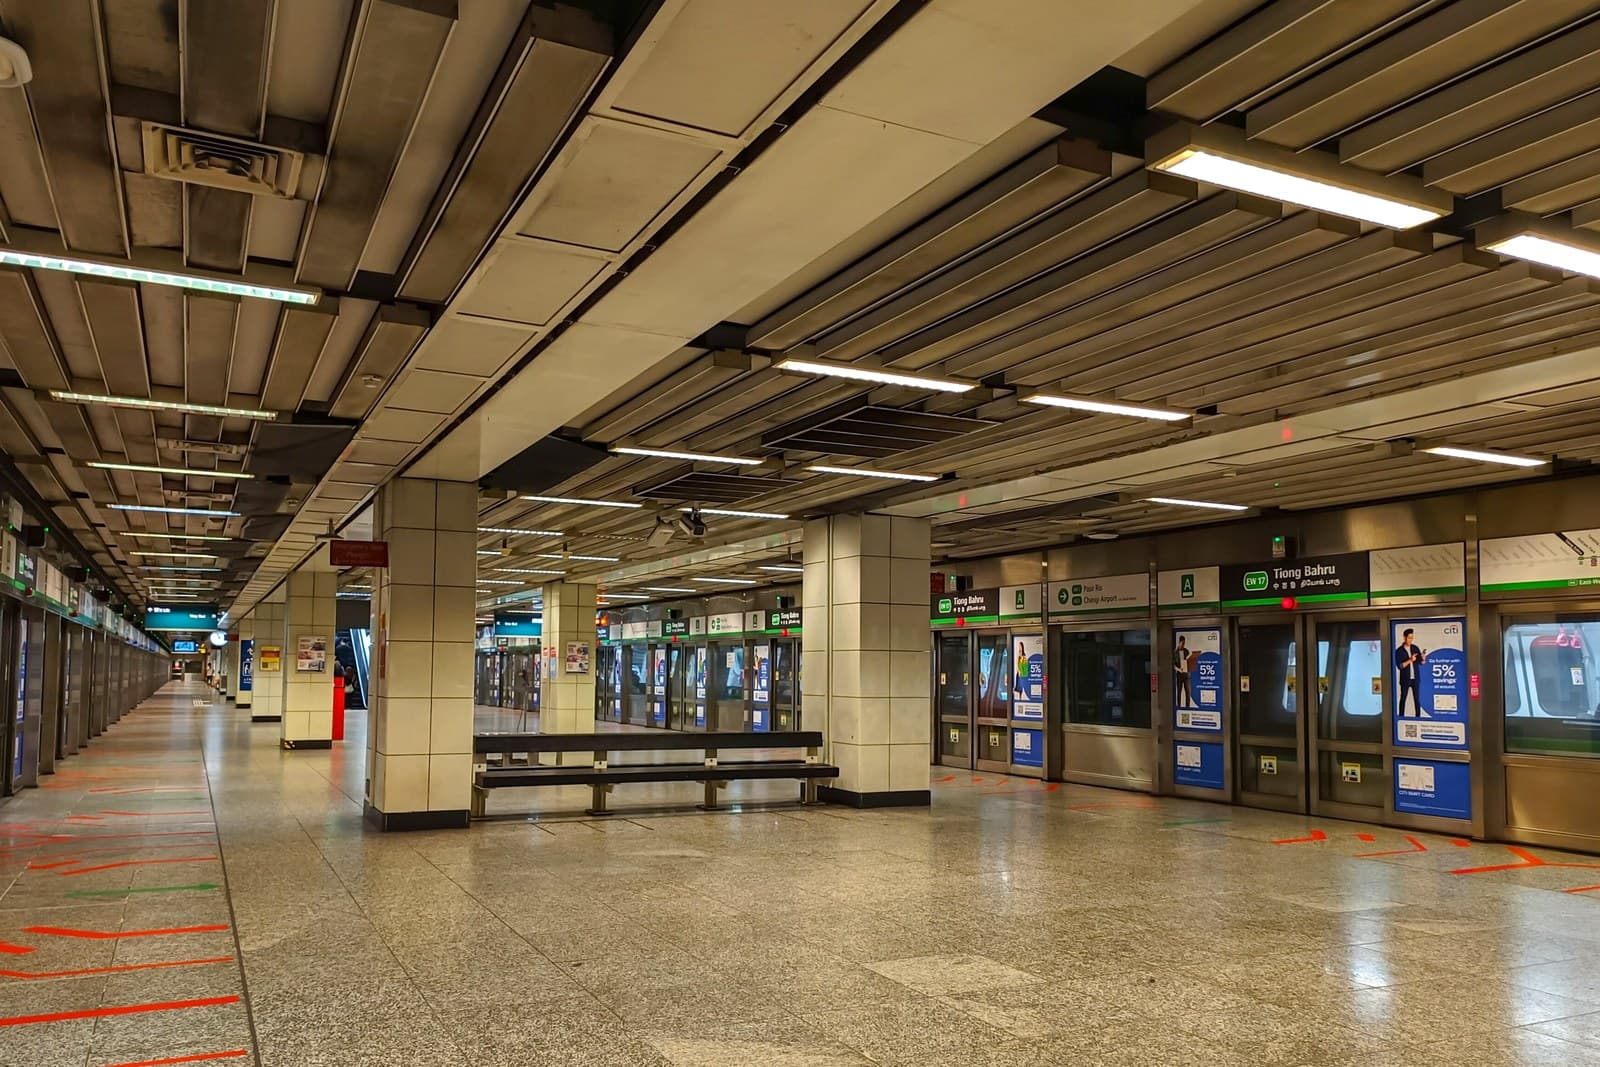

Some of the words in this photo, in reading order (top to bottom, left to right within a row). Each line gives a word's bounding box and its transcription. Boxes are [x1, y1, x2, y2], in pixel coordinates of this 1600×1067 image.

[1273, 568, 1302, 580] Tiong
[1304, 564, 1335, 577] Bahru
[1184, 579, 1192, 591] A
[1258, 576, 1266, 585] 17
[953, 597, 968, 606] Tiong
[968, 595, 984, 604] Bahru
[1444, 625, 1458, 635] citi
[1199, 664, 1215, 675] 5%
[1432, 664, 1455, 677] 5%
